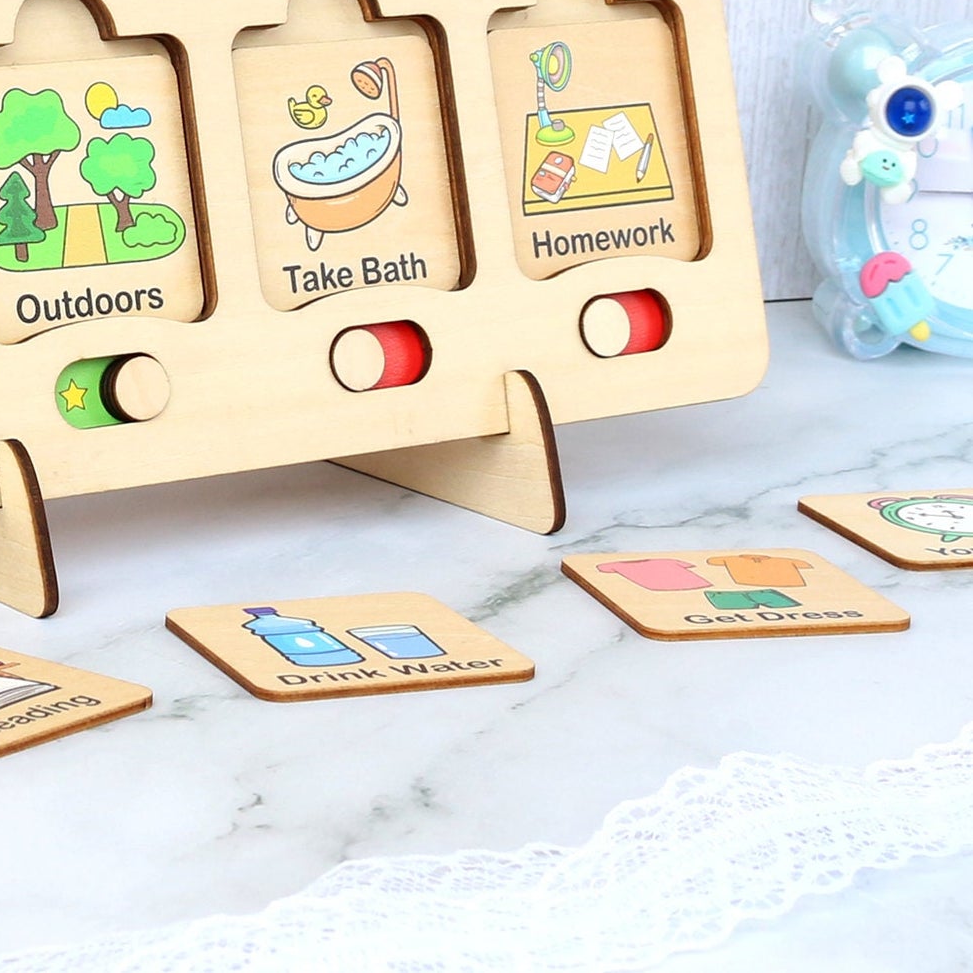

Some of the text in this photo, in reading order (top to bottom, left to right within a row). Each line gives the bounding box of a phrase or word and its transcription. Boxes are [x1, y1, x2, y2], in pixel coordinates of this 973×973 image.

[531, 217, 676, 259] Homework
[908, 218, 929, 251] 8
[282, 252, 427, 296] Take Bath
[935, 253, 955, 276] 7
[15, 286, 165, 324] Outdoors
[925, 547, 973, 556] Yo
[683, 610, 864, 625] Get Dress
[276, 658, 505, 686] Drink Water
